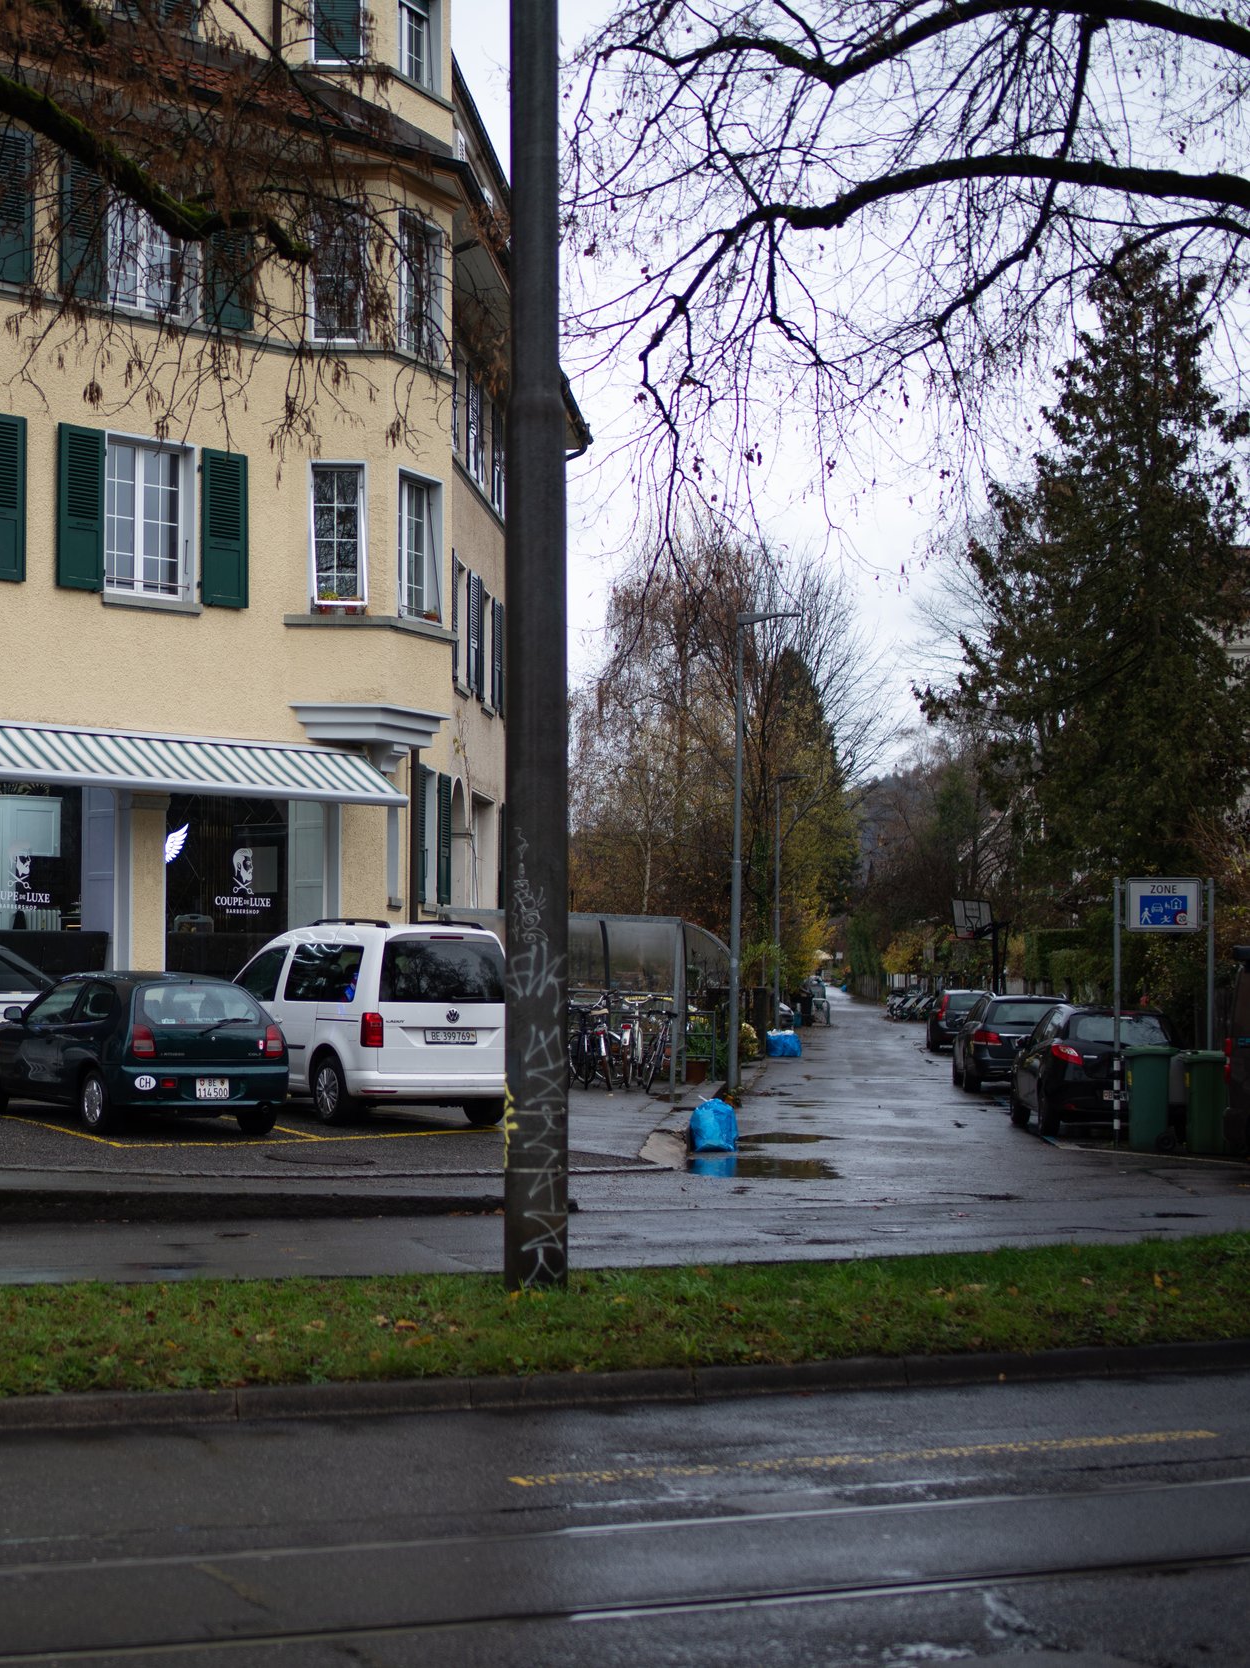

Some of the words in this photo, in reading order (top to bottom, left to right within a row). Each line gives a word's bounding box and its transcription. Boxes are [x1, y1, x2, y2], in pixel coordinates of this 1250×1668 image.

[1150, 884, 1177, 894] ZONE
[26, 892, 50, 903] LUXE
[214, 895, 243, 906] COUPE
[249, 897, 271, 907] LUXE
[138, 1077, 151, 1089] CH
[208, 1079, 216, 1087] BE
